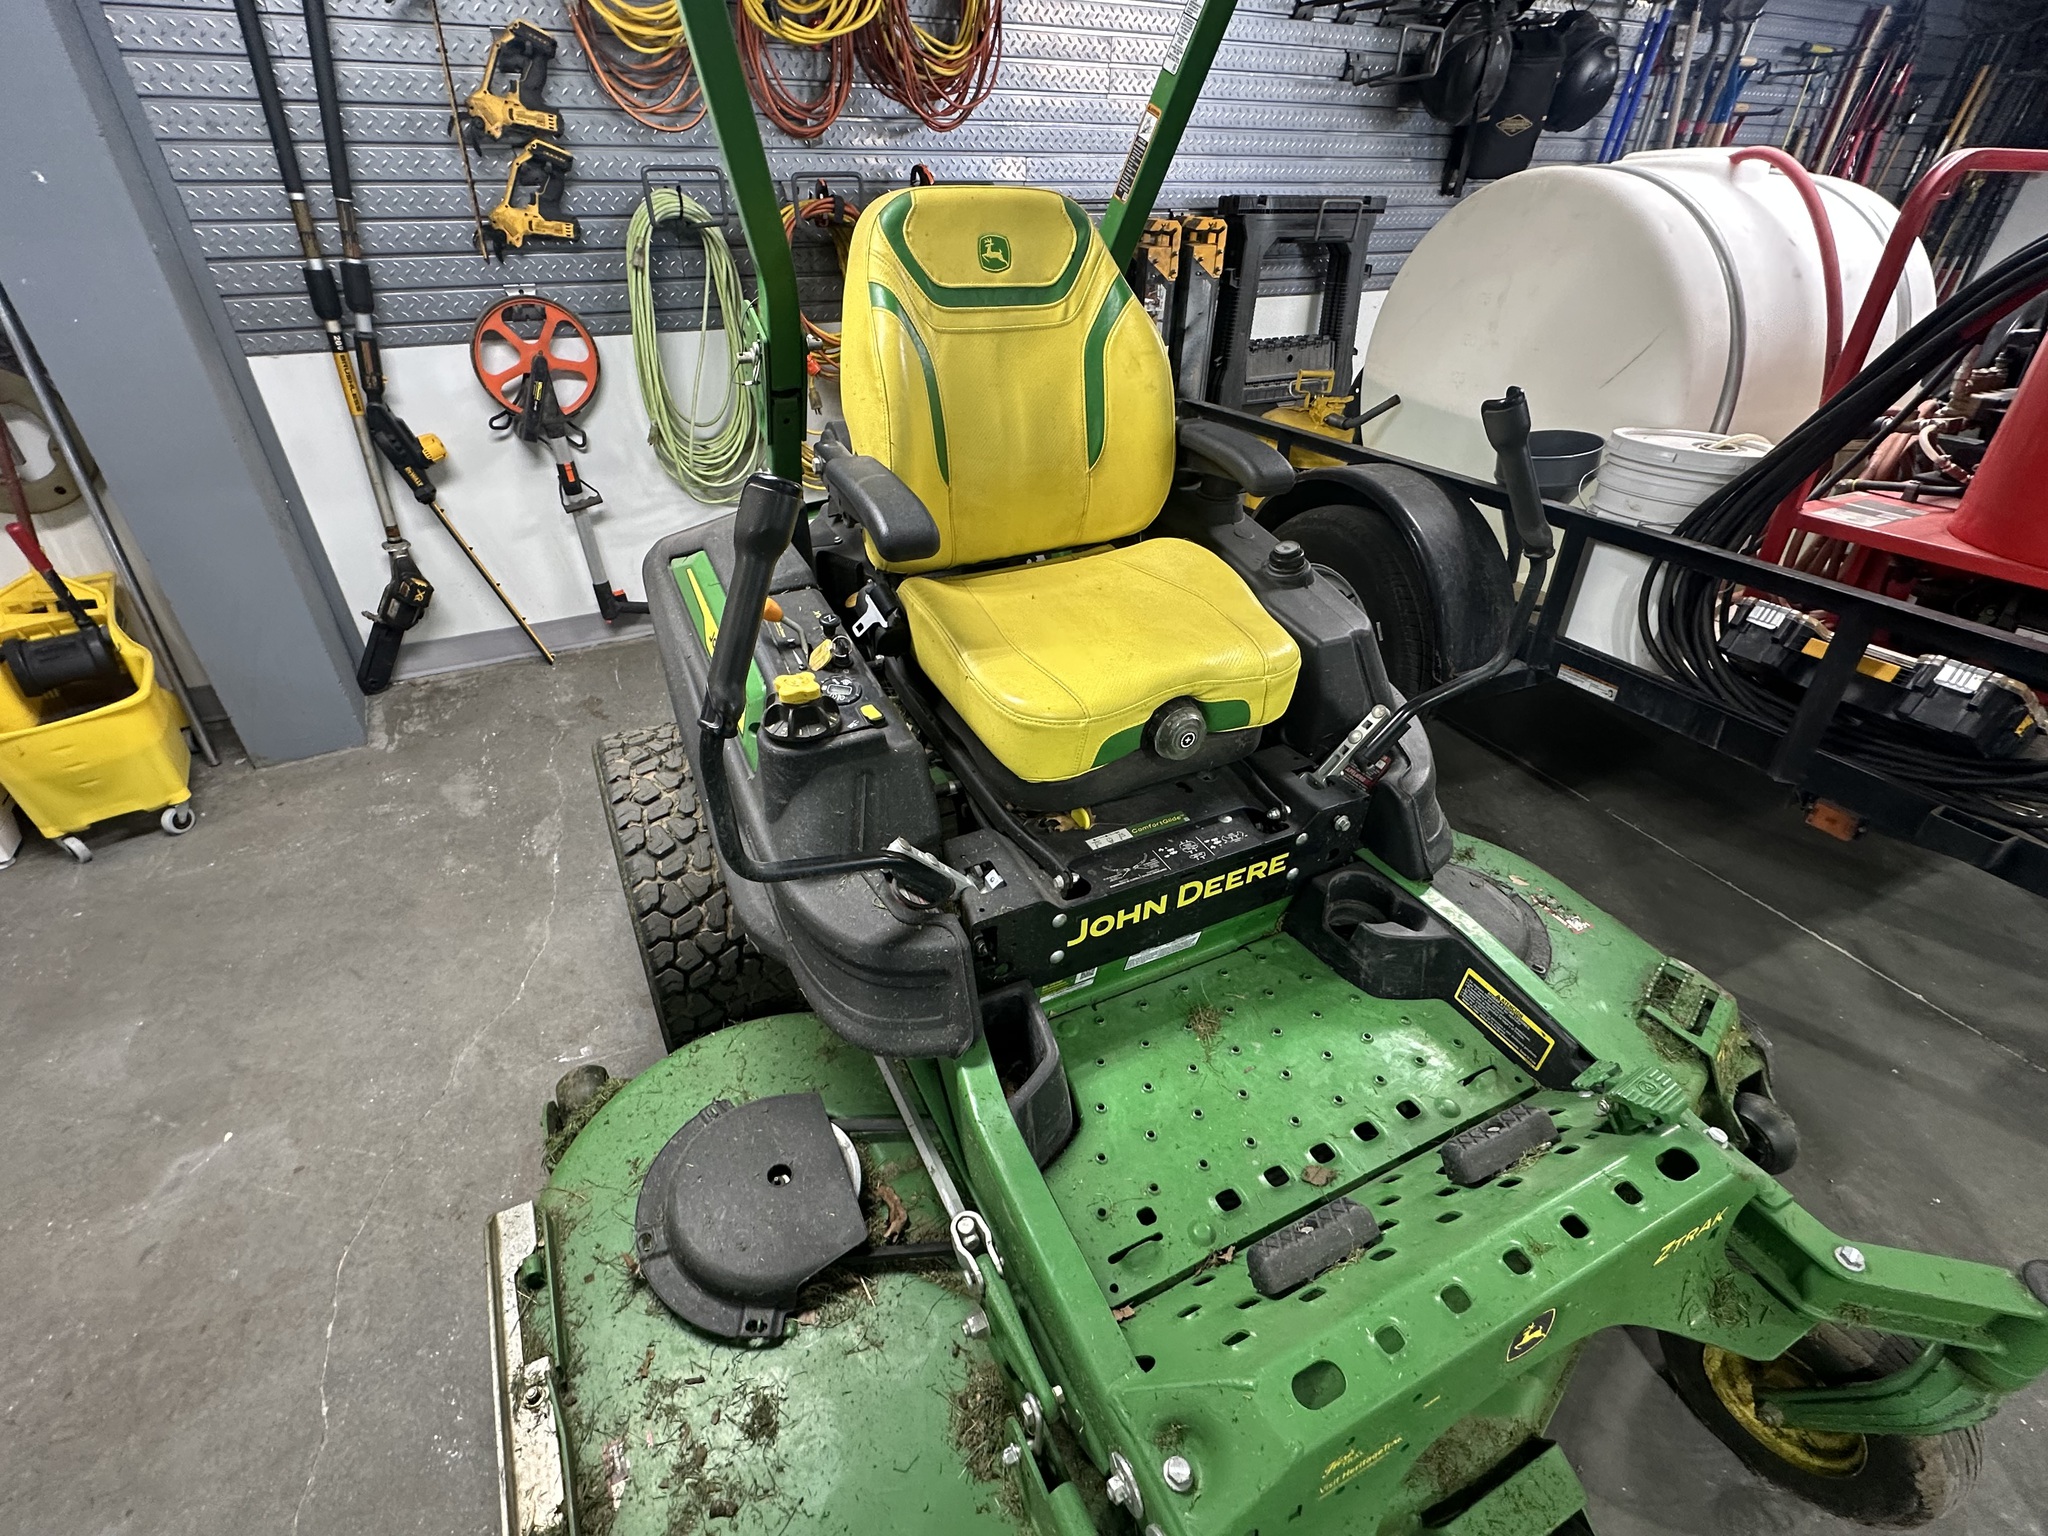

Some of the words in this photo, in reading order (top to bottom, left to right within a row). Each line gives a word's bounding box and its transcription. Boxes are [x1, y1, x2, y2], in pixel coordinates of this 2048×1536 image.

[339, 354, 362, 412] BRUSHLESS
[1066, 894, 1168, 948] JOHN
[1176, 852, 1290, 909] DEERE
[1653, 1206, 1729, 1267] ZTRAK
